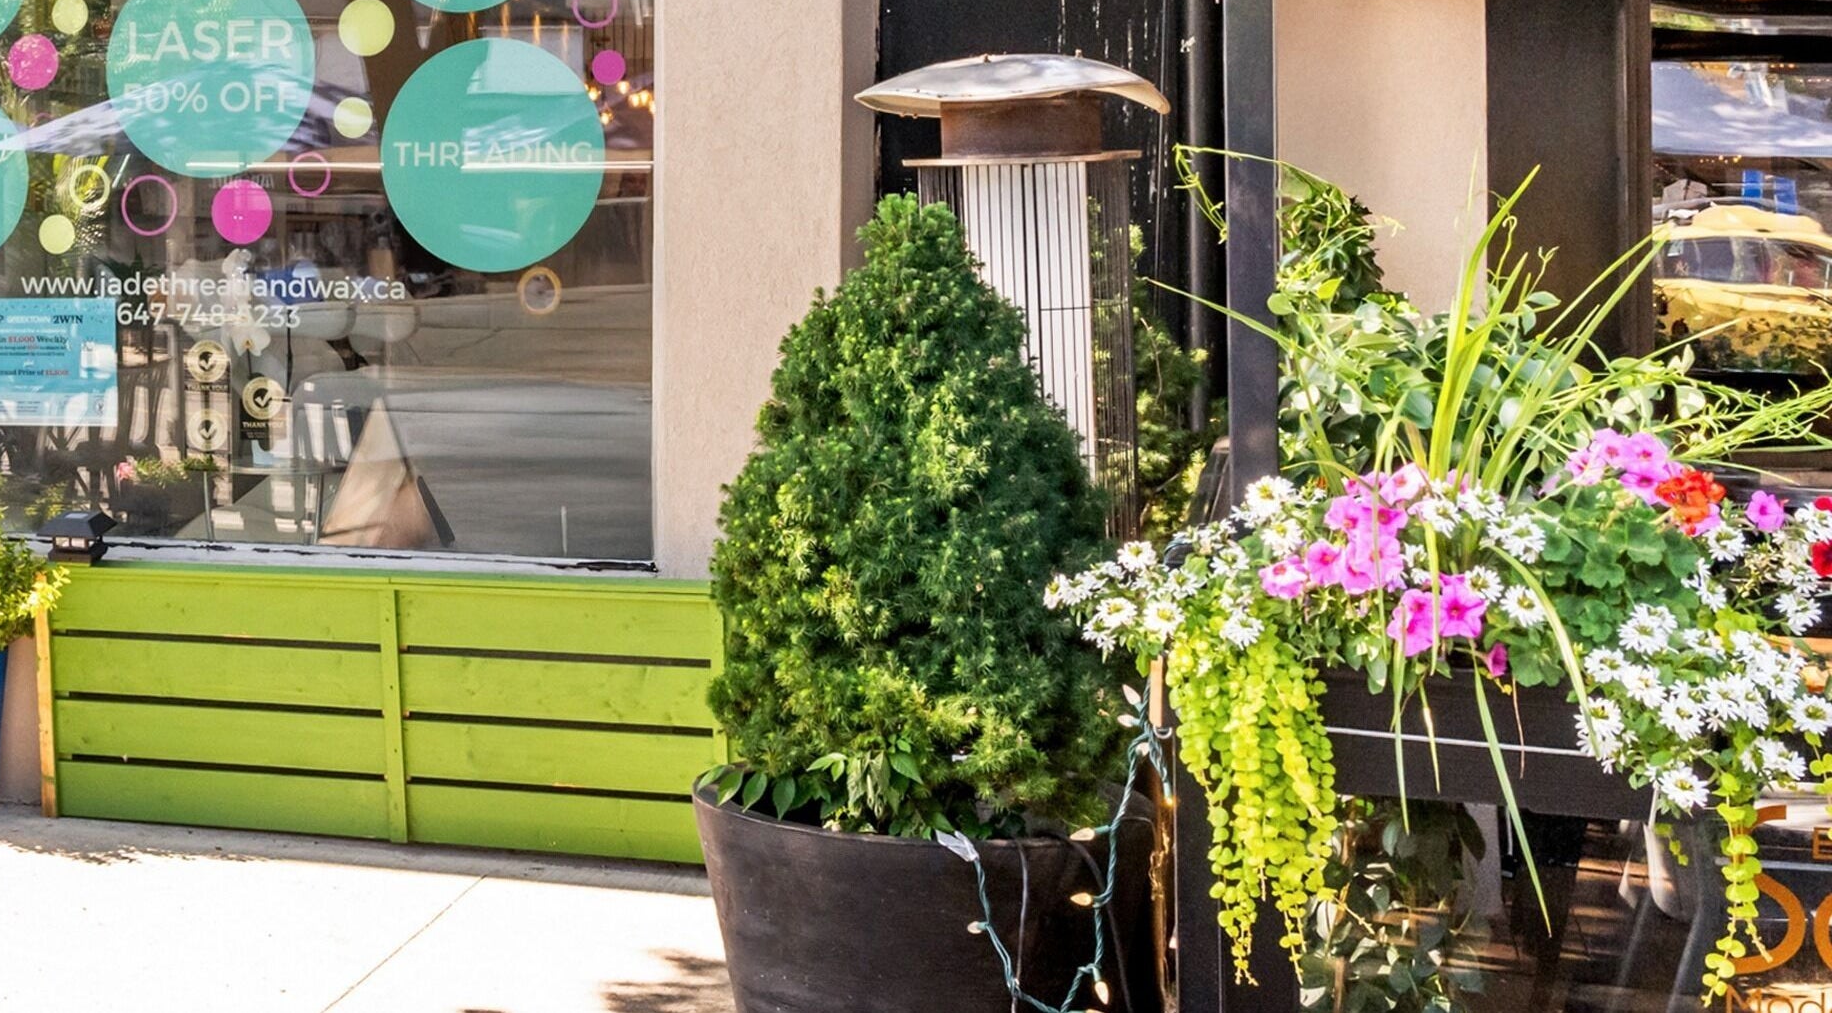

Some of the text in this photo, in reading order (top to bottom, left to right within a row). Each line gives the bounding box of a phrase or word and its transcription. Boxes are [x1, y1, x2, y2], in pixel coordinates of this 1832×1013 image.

[127, 19, 294, 61] LASER
[123, 81, 299, 114] 50% OFF
[392, 141, 594, 169] THREADING
